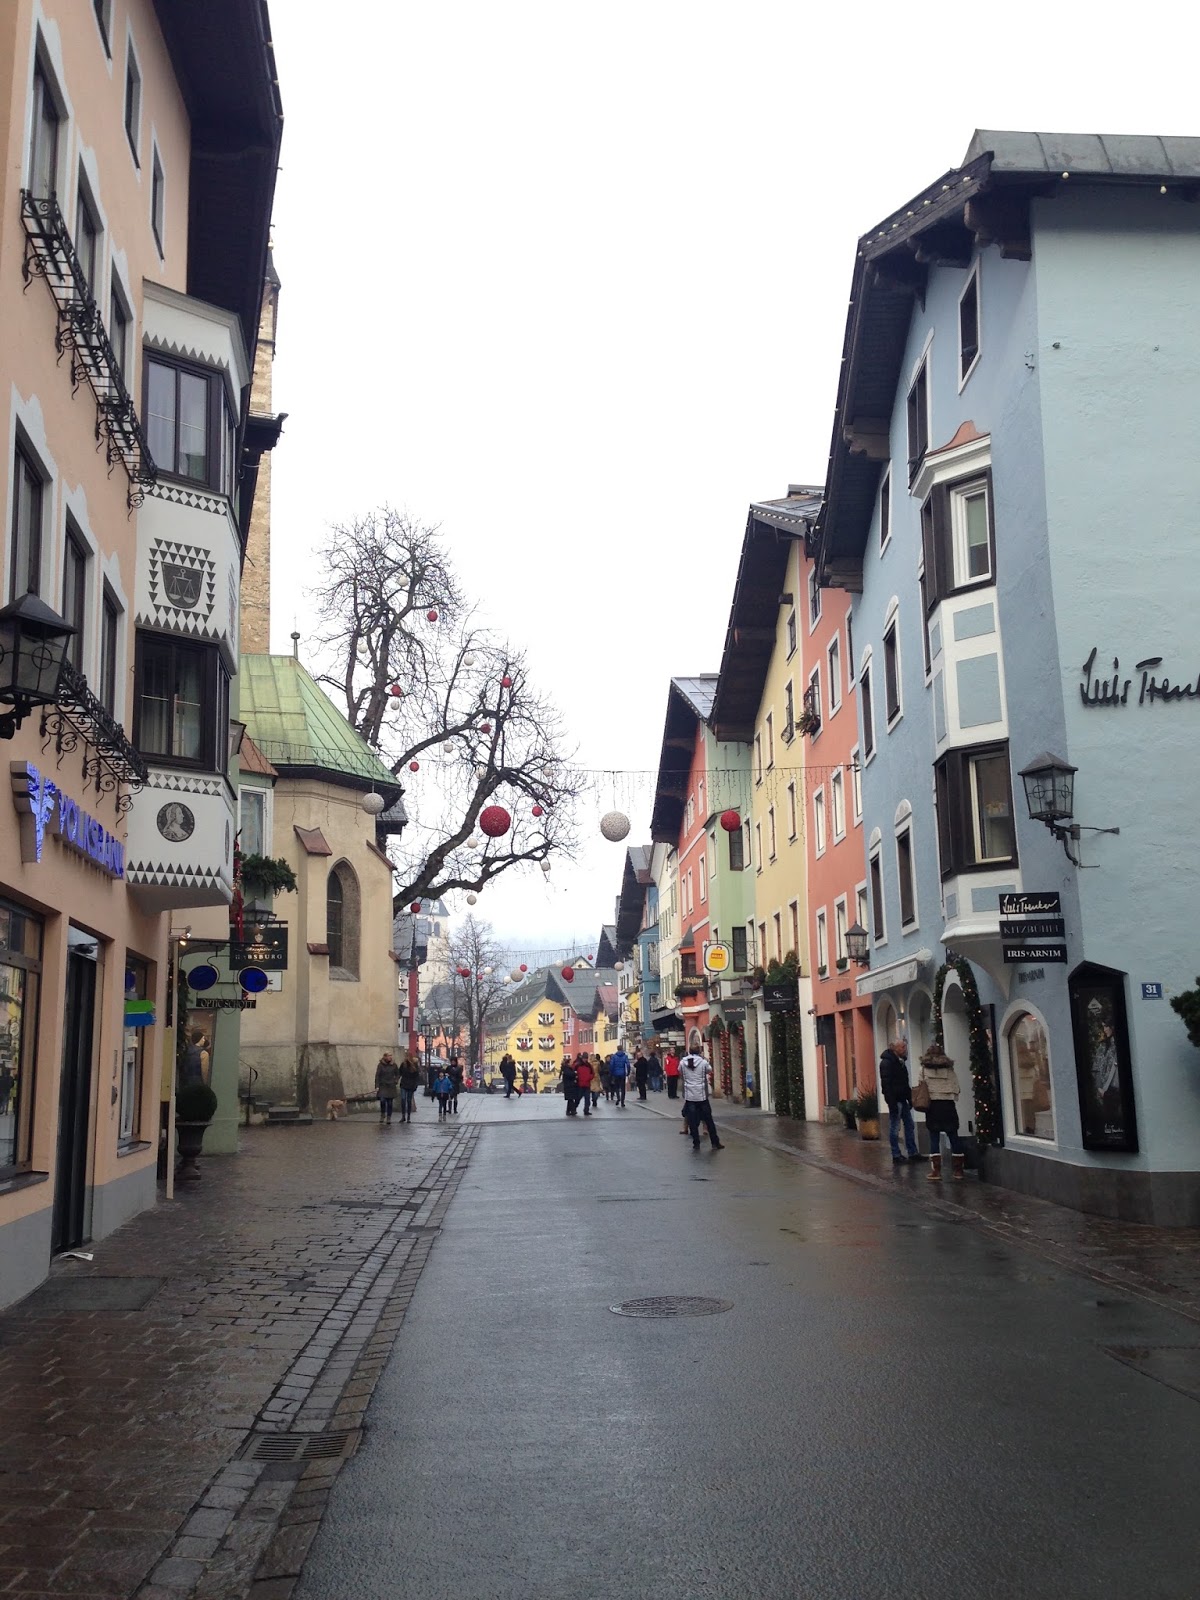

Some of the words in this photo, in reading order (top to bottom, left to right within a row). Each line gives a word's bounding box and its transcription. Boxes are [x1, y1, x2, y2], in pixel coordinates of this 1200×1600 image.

[1080, 647, 1132, 705] Luis
[58, 788, 125, 879] VOLKSBANK
[1003, 895, 1020, 913] Luis
[1019, 897, 1058, 912] Trenker
[1029, 949, 1061, 957] ARNIM
[1145, 984, 1158, 994] 31
[200, 999, 222, 1008] OPTIC
[224, 1000, 254, 1009] SCHOTT
